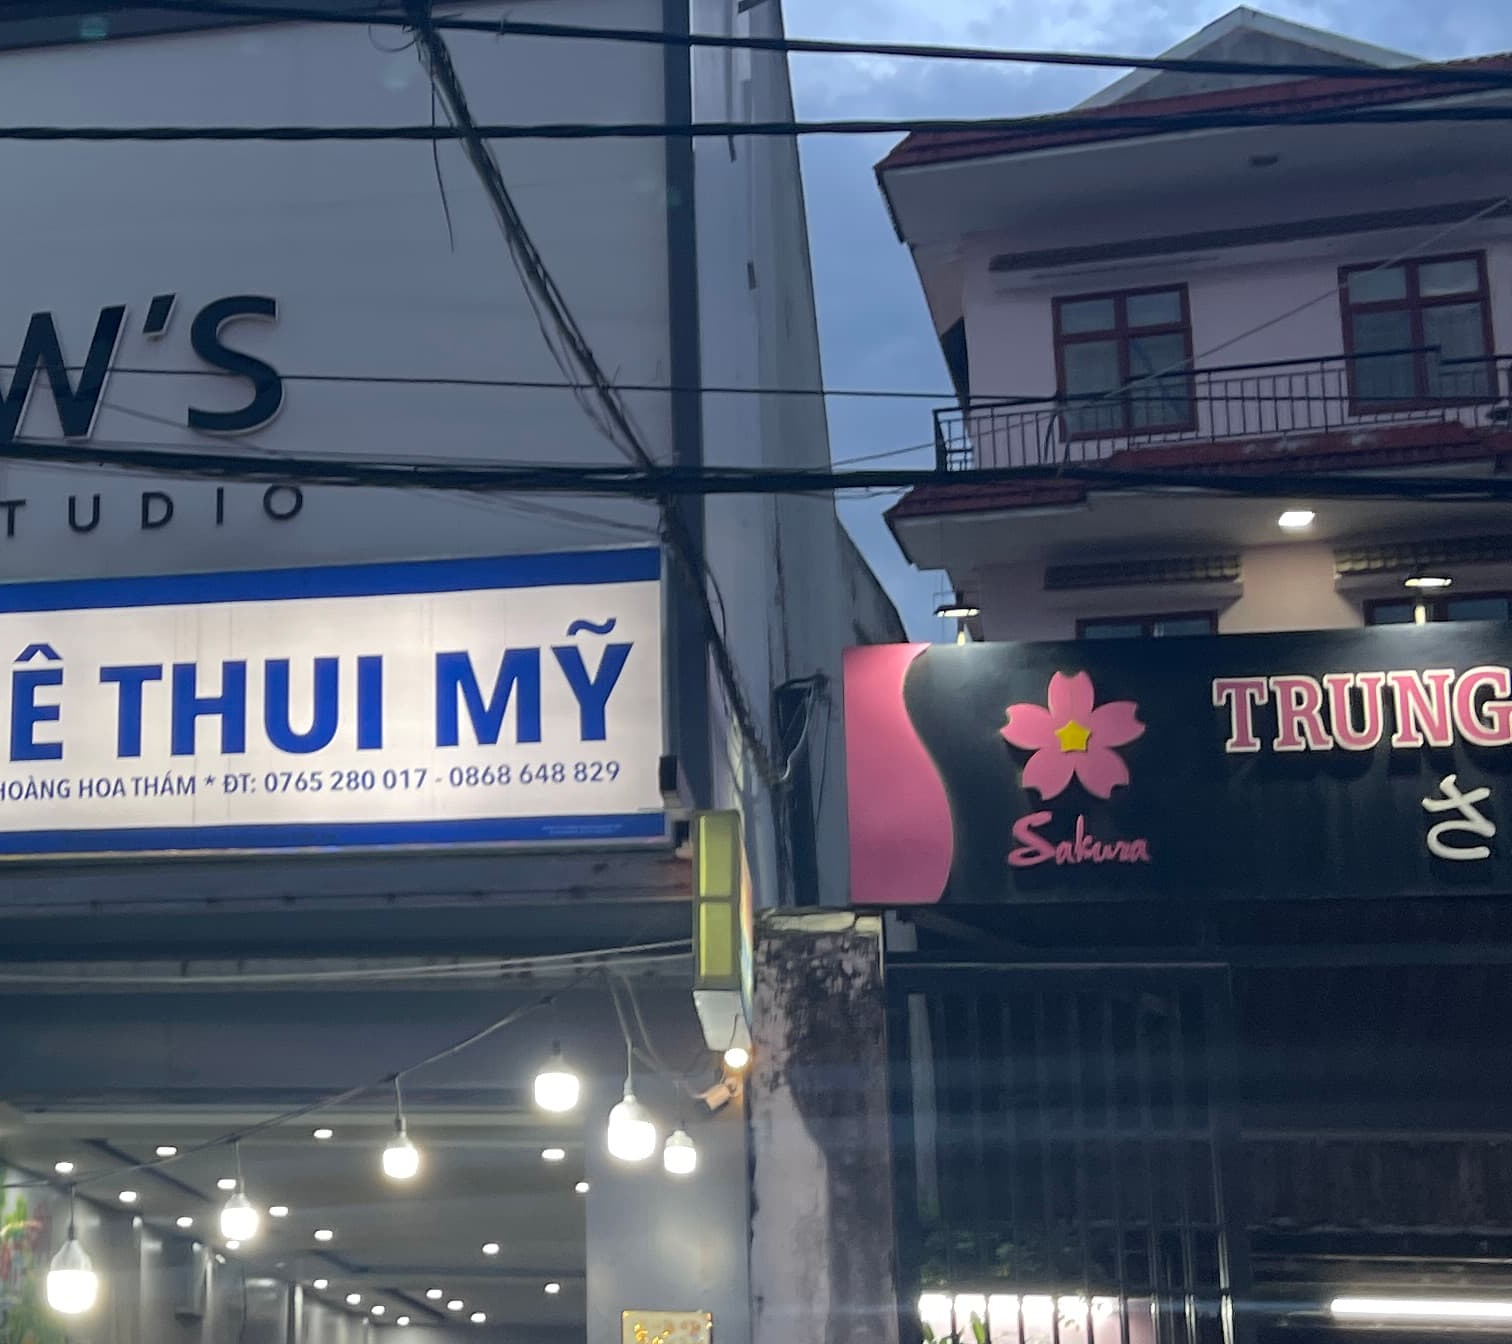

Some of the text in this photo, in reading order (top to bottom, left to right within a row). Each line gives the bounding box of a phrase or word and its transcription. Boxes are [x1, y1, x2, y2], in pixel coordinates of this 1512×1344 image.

[99, 654, 383, 757] THUI
[434, 617, 635, 747] MỸ
[1211, 665, 1512, 754] TRUNG
[78, 777, 124, 799] HOA
[130, 770, 196, 797] THÁM
[223, 773, 256, 794] ĐT:
[264, 771, 323, 793] 0765
[330, 769, 375, 791] 280
[382, 767, 428, 790] 017
[449, 764, 512, 788] 0868
[519, 762, 566, 784] 648
[573, 760, 621, 782] 829
[1421, 773, 1496, 861] さ
[1007, 810, 1152, 868] Sakura
